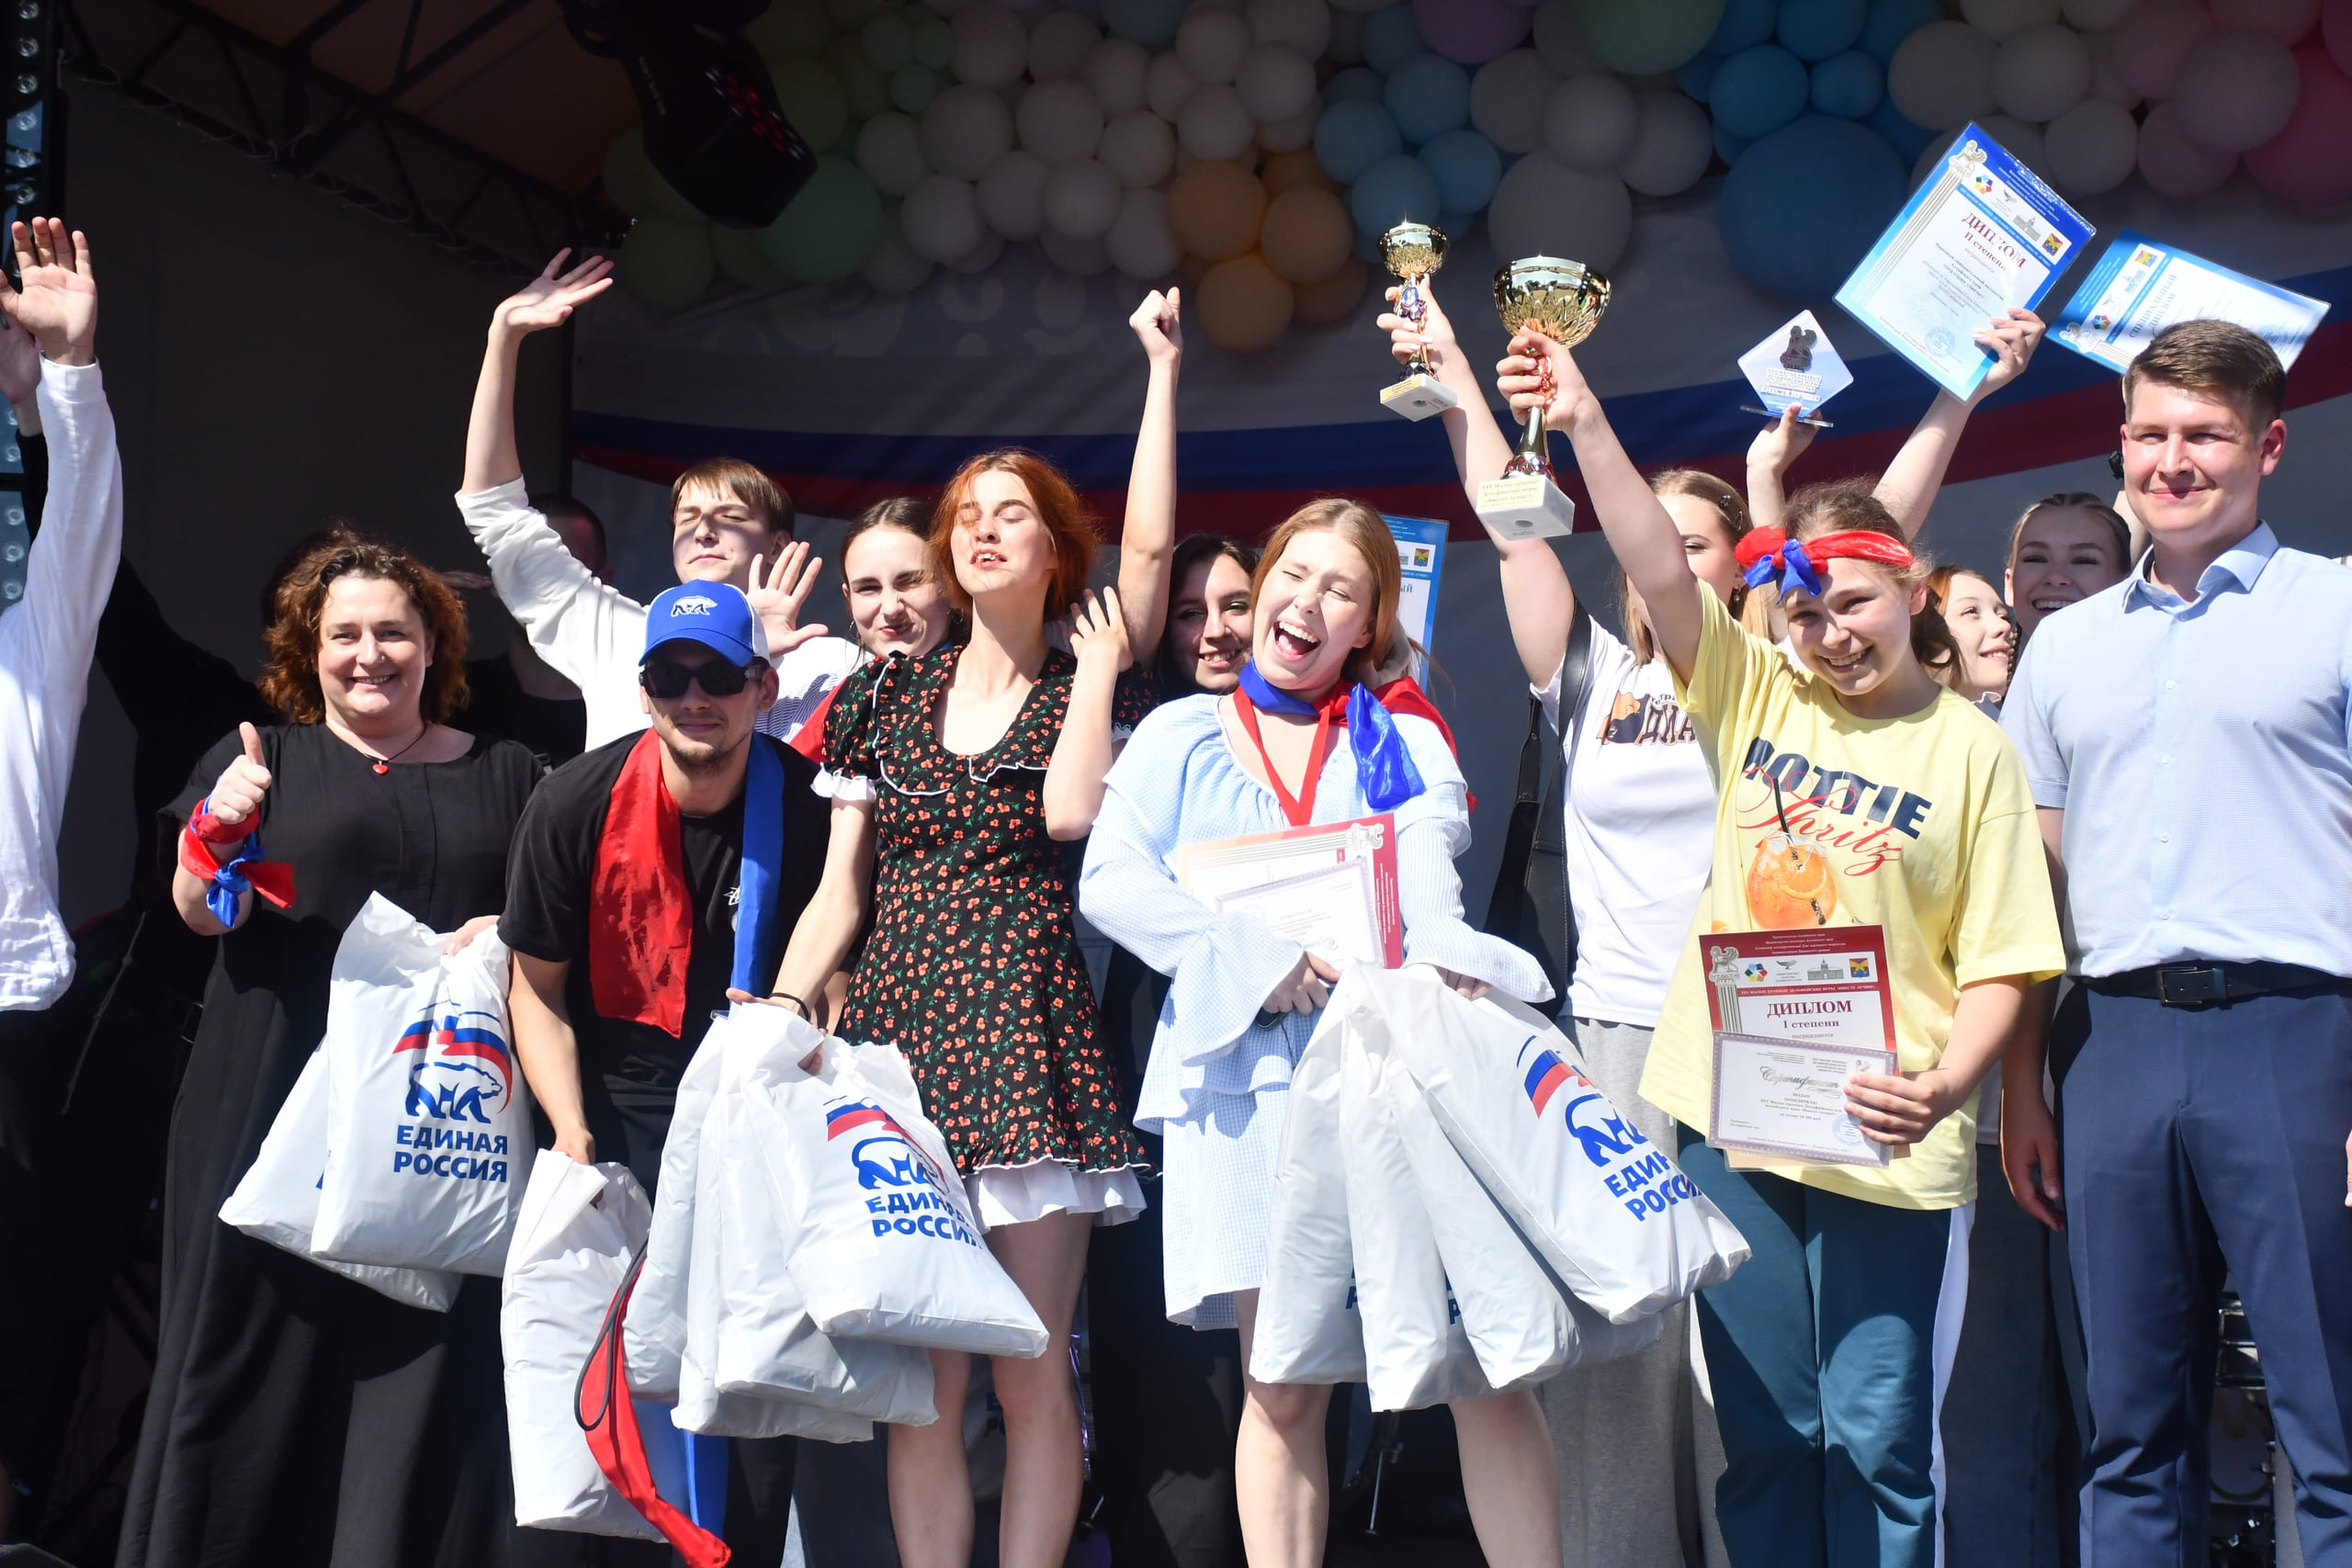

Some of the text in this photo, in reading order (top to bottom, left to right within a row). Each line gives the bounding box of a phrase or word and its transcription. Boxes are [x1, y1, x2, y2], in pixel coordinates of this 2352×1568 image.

[1634, 702, 1696, 746] ДИА
[1767, 999, 1852, 1019] ДИПЛОМ
[1782, 1020, 1839, 1029] I степени
[396, 1124, 508, 1156] ЕДИНАЯ
[393, 1151, 508, 1183] РОССИЯ
[1603, 1150, 1670, 1198] ЕДИН
[1624, 1174, 1702, 1222] РОССИ
